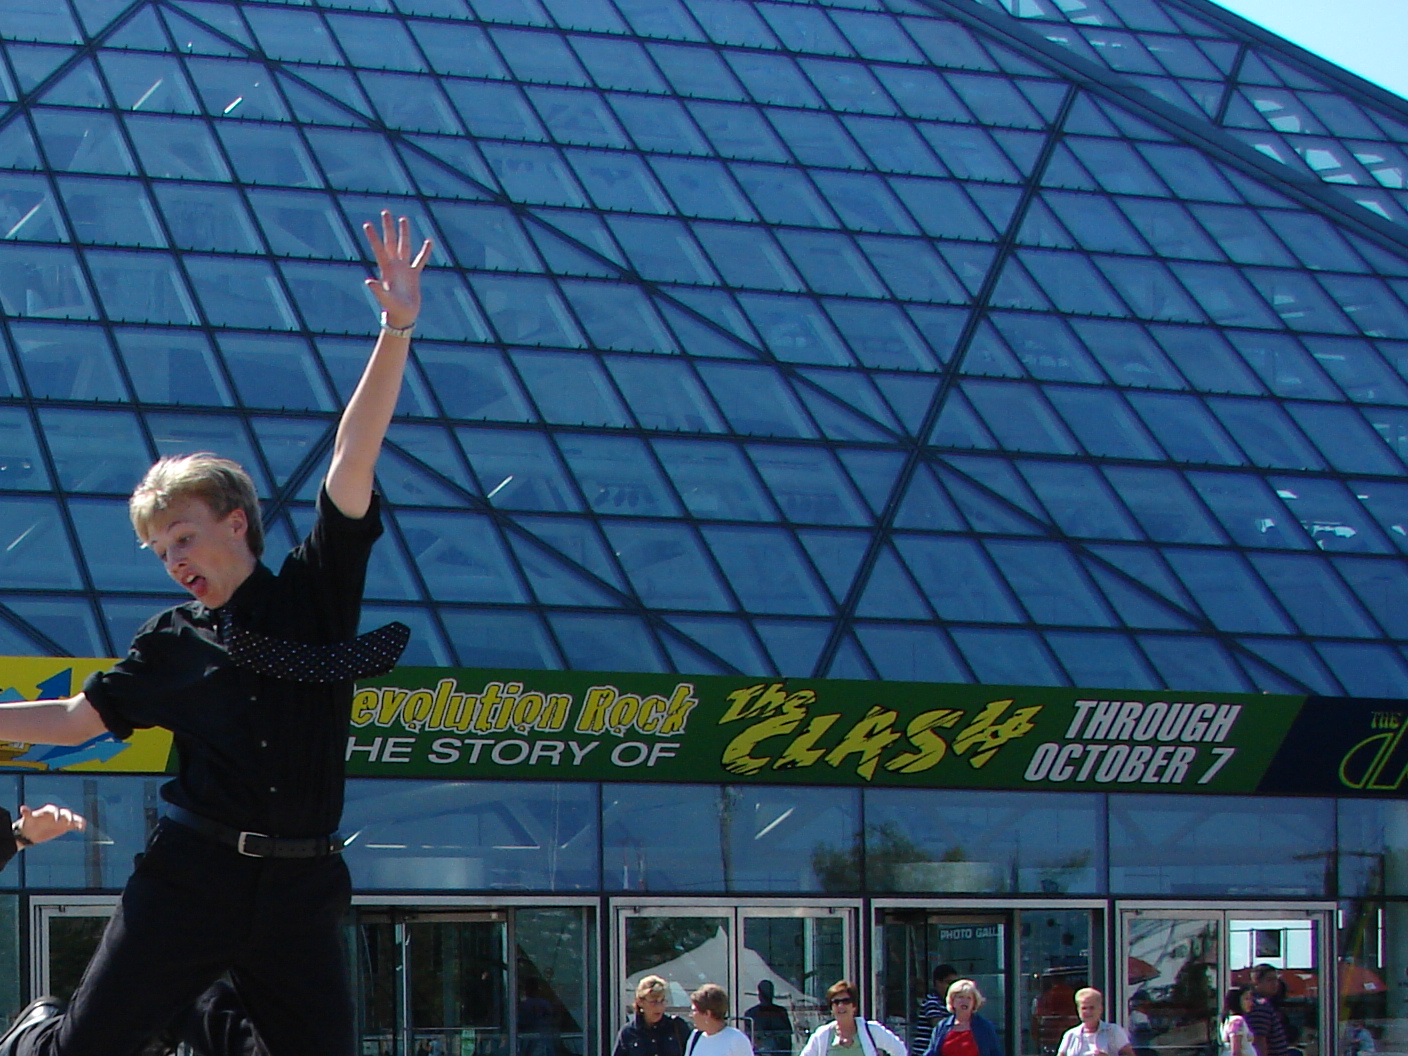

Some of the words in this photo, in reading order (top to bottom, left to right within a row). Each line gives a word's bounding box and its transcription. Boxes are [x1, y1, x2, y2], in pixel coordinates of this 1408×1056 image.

[350, 678, 573, 736] evolution
[574, 683, 699, 738] Rock
[1064, 700, 1242, 743] THROUGH
[1371, 711, 1402, 729] THE
[345, 736, 416, 763] HE
[428, 737, 600, 766] STORY
[610, 741, 681, 767] OF
[721, 699, 1044, 782] CLASH
[1023, 743, 1196, 784] OCTOBER
[1197, 747, 1235, 784] 7
[940, 929, 972, 940] PHOTO
[975, 927, 999, 938] GALL
